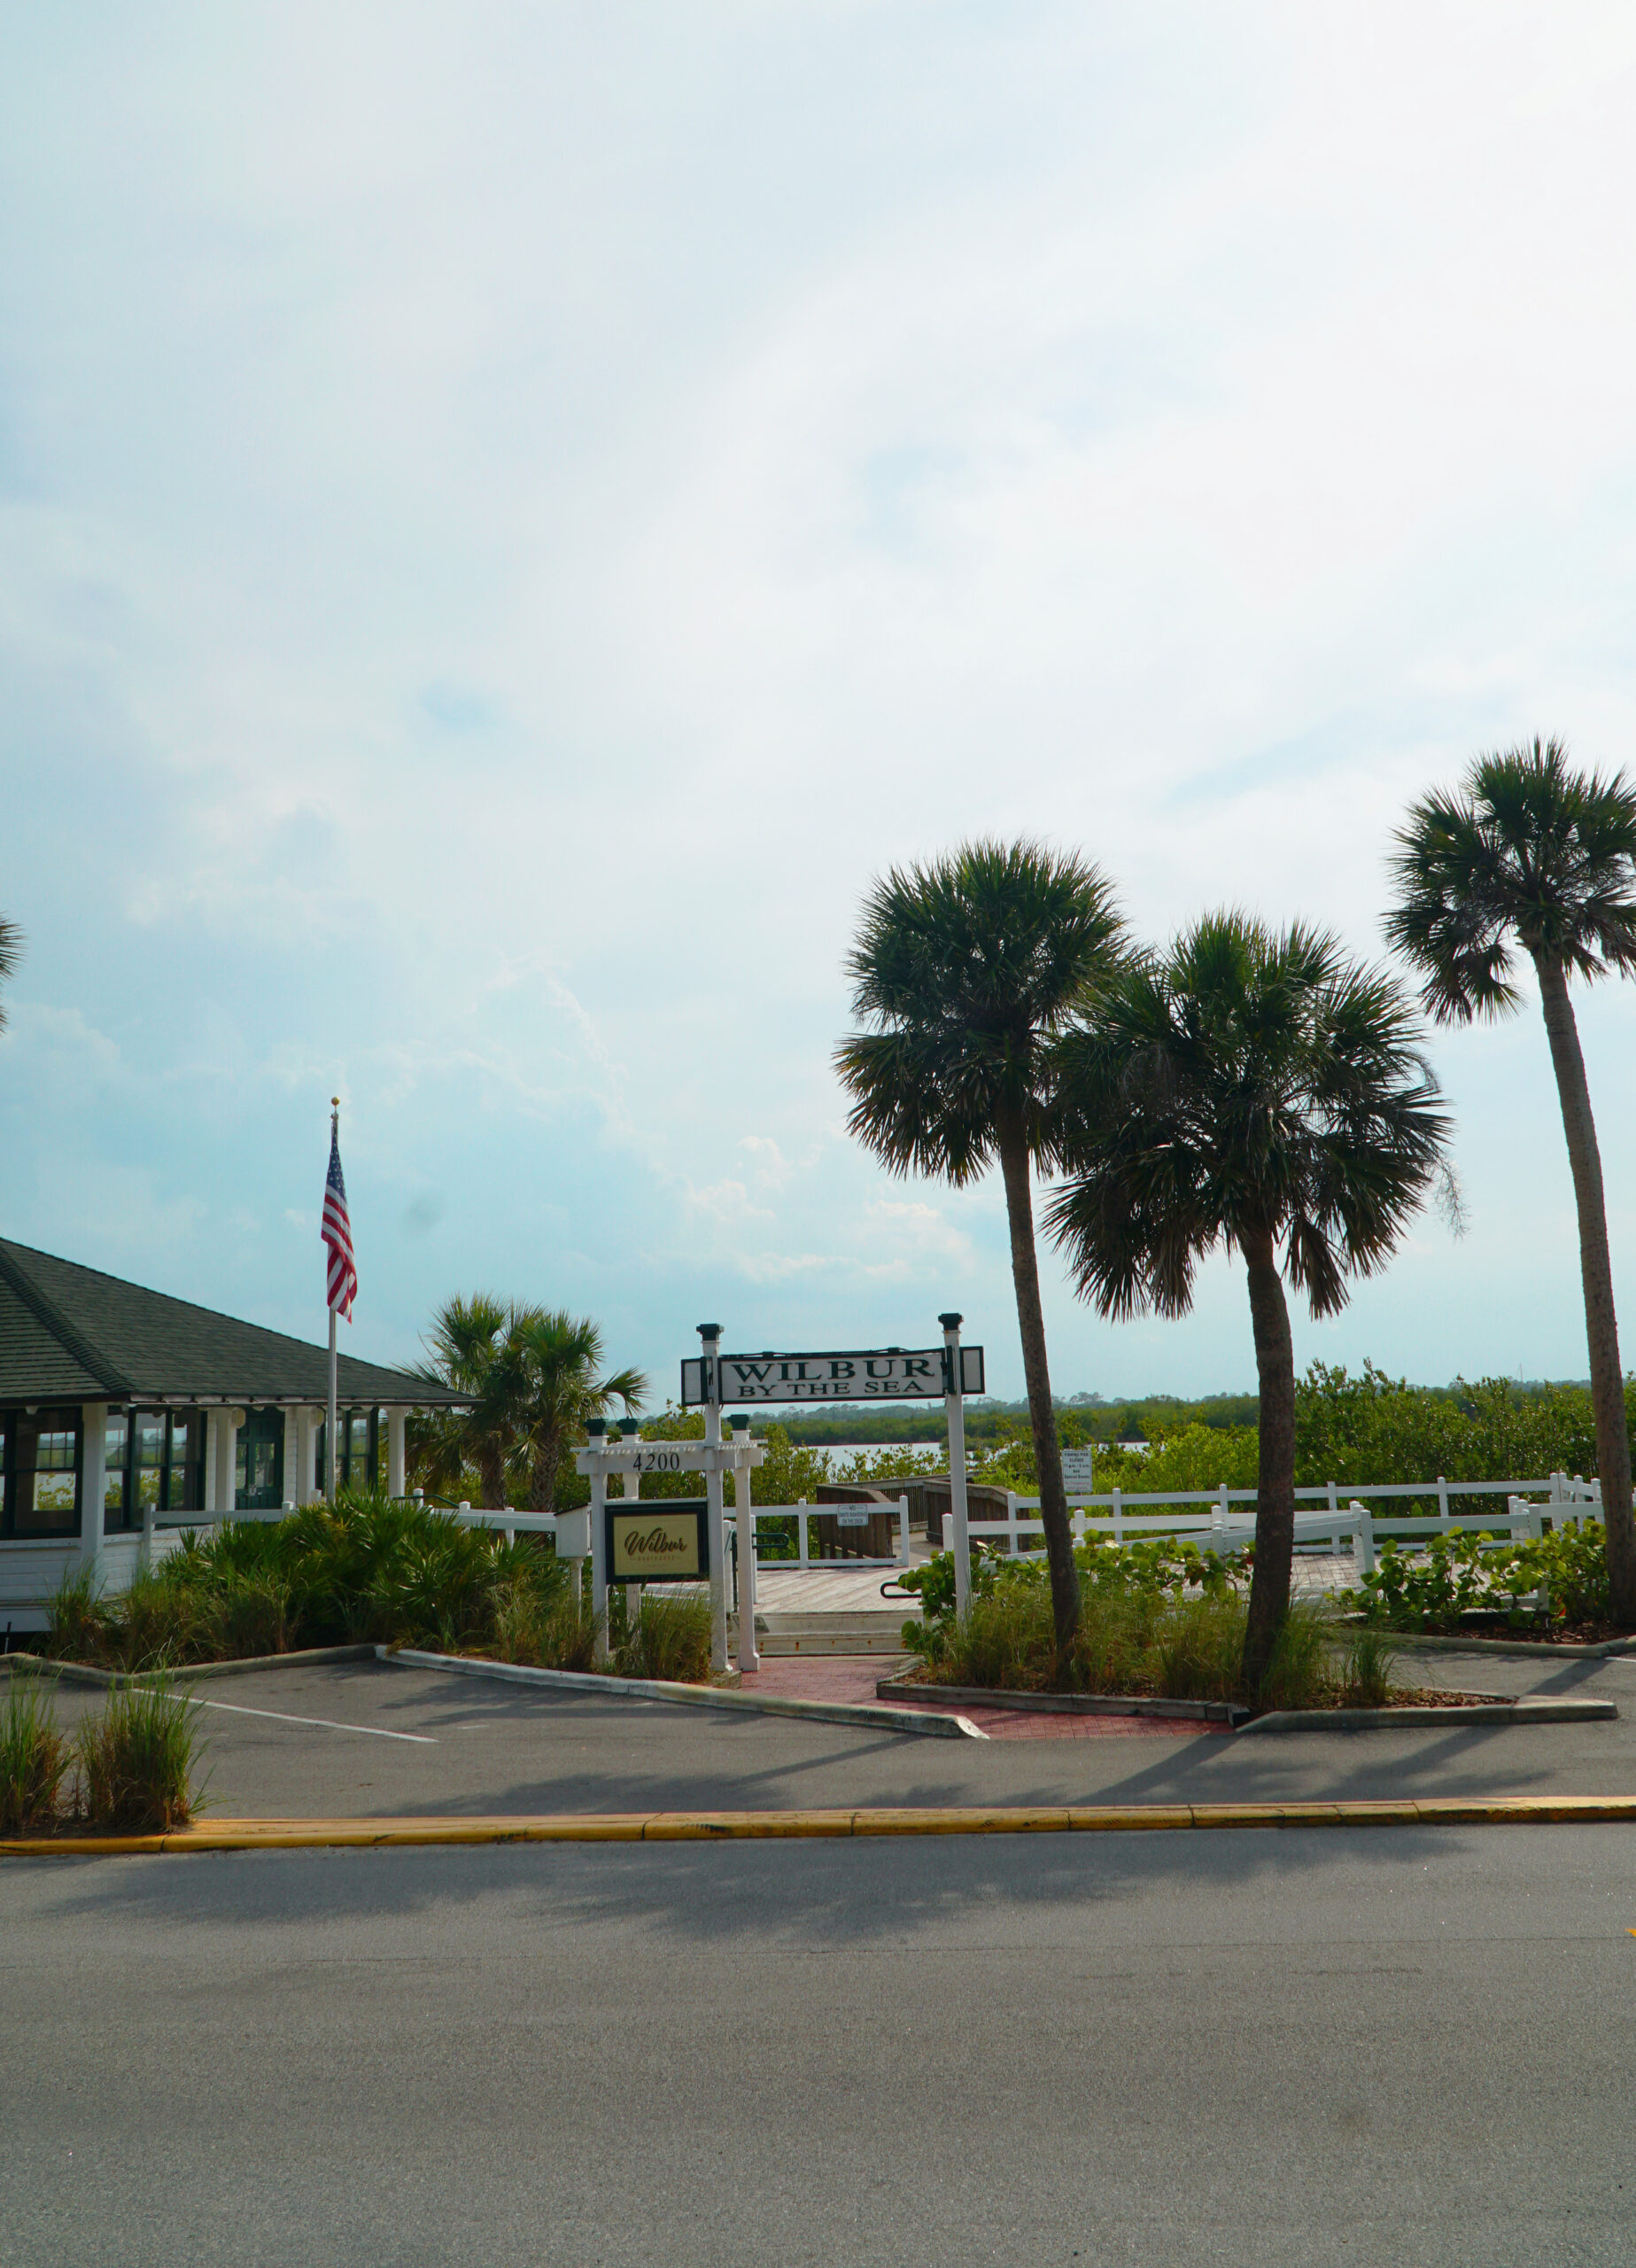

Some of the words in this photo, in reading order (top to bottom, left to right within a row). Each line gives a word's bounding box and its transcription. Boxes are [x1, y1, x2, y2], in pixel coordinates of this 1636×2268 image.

[731, 1358, 935, 1383] WILBUR
[737, 1384, 778, 1397] BY
[787, 1382, 851, 1396] THE
[864, 1380, 926, 1394] SEA
[632, 1452, 680, 1472] 4200
[624, 1527, 688, 1557] Wilbur
